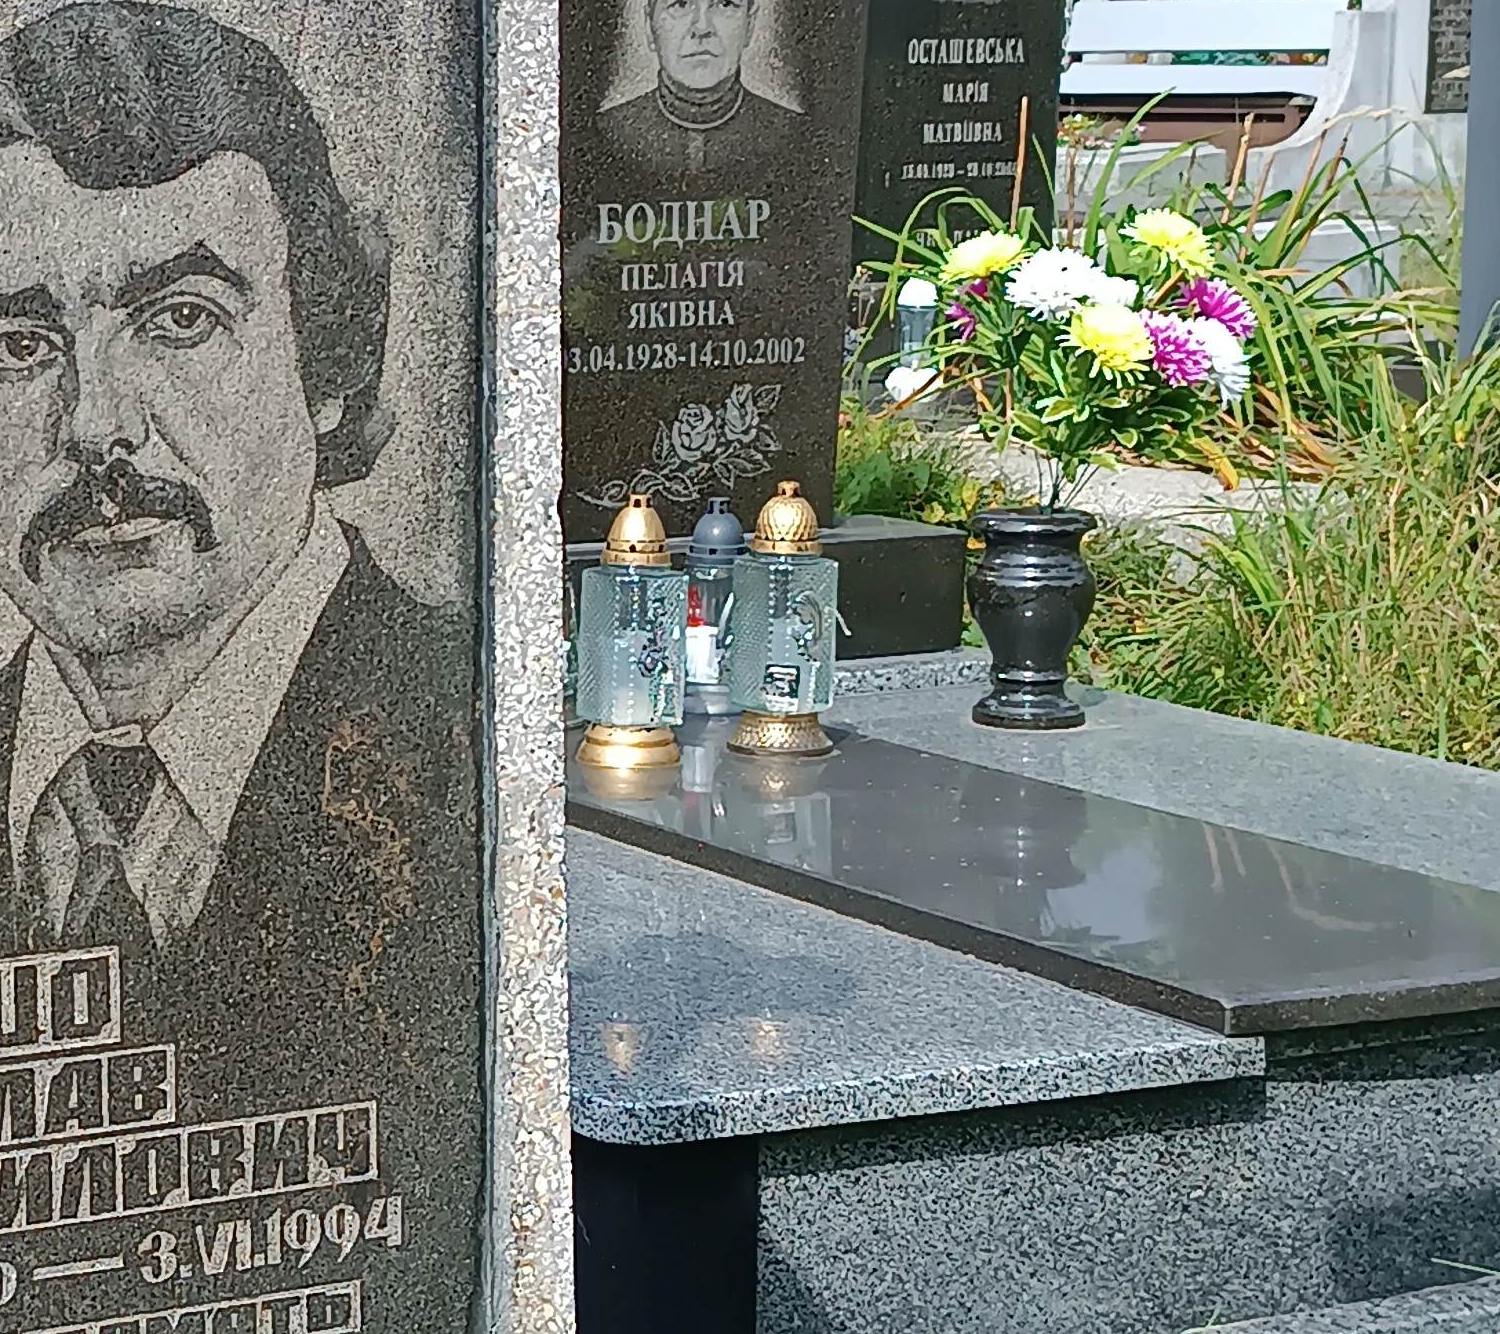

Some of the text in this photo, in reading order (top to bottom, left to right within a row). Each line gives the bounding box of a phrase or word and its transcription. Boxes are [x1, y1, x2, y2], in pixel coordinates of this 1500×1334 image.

[907, 38, 1025, 65] ОСТАШЕВСЬКА
[941, 79, 990, 104] МАРІЯ
[596, 199, 771, 252] БОДНАР
[620, 260, 745, 292] ПЕЛАГІЯ
[627, 299, 735, 330] ЯКІВНА
[563, 337, 806, 375] 3.04.1928-14.10.2002
[138, 1195, 402, 1284] 3.VI.1994
